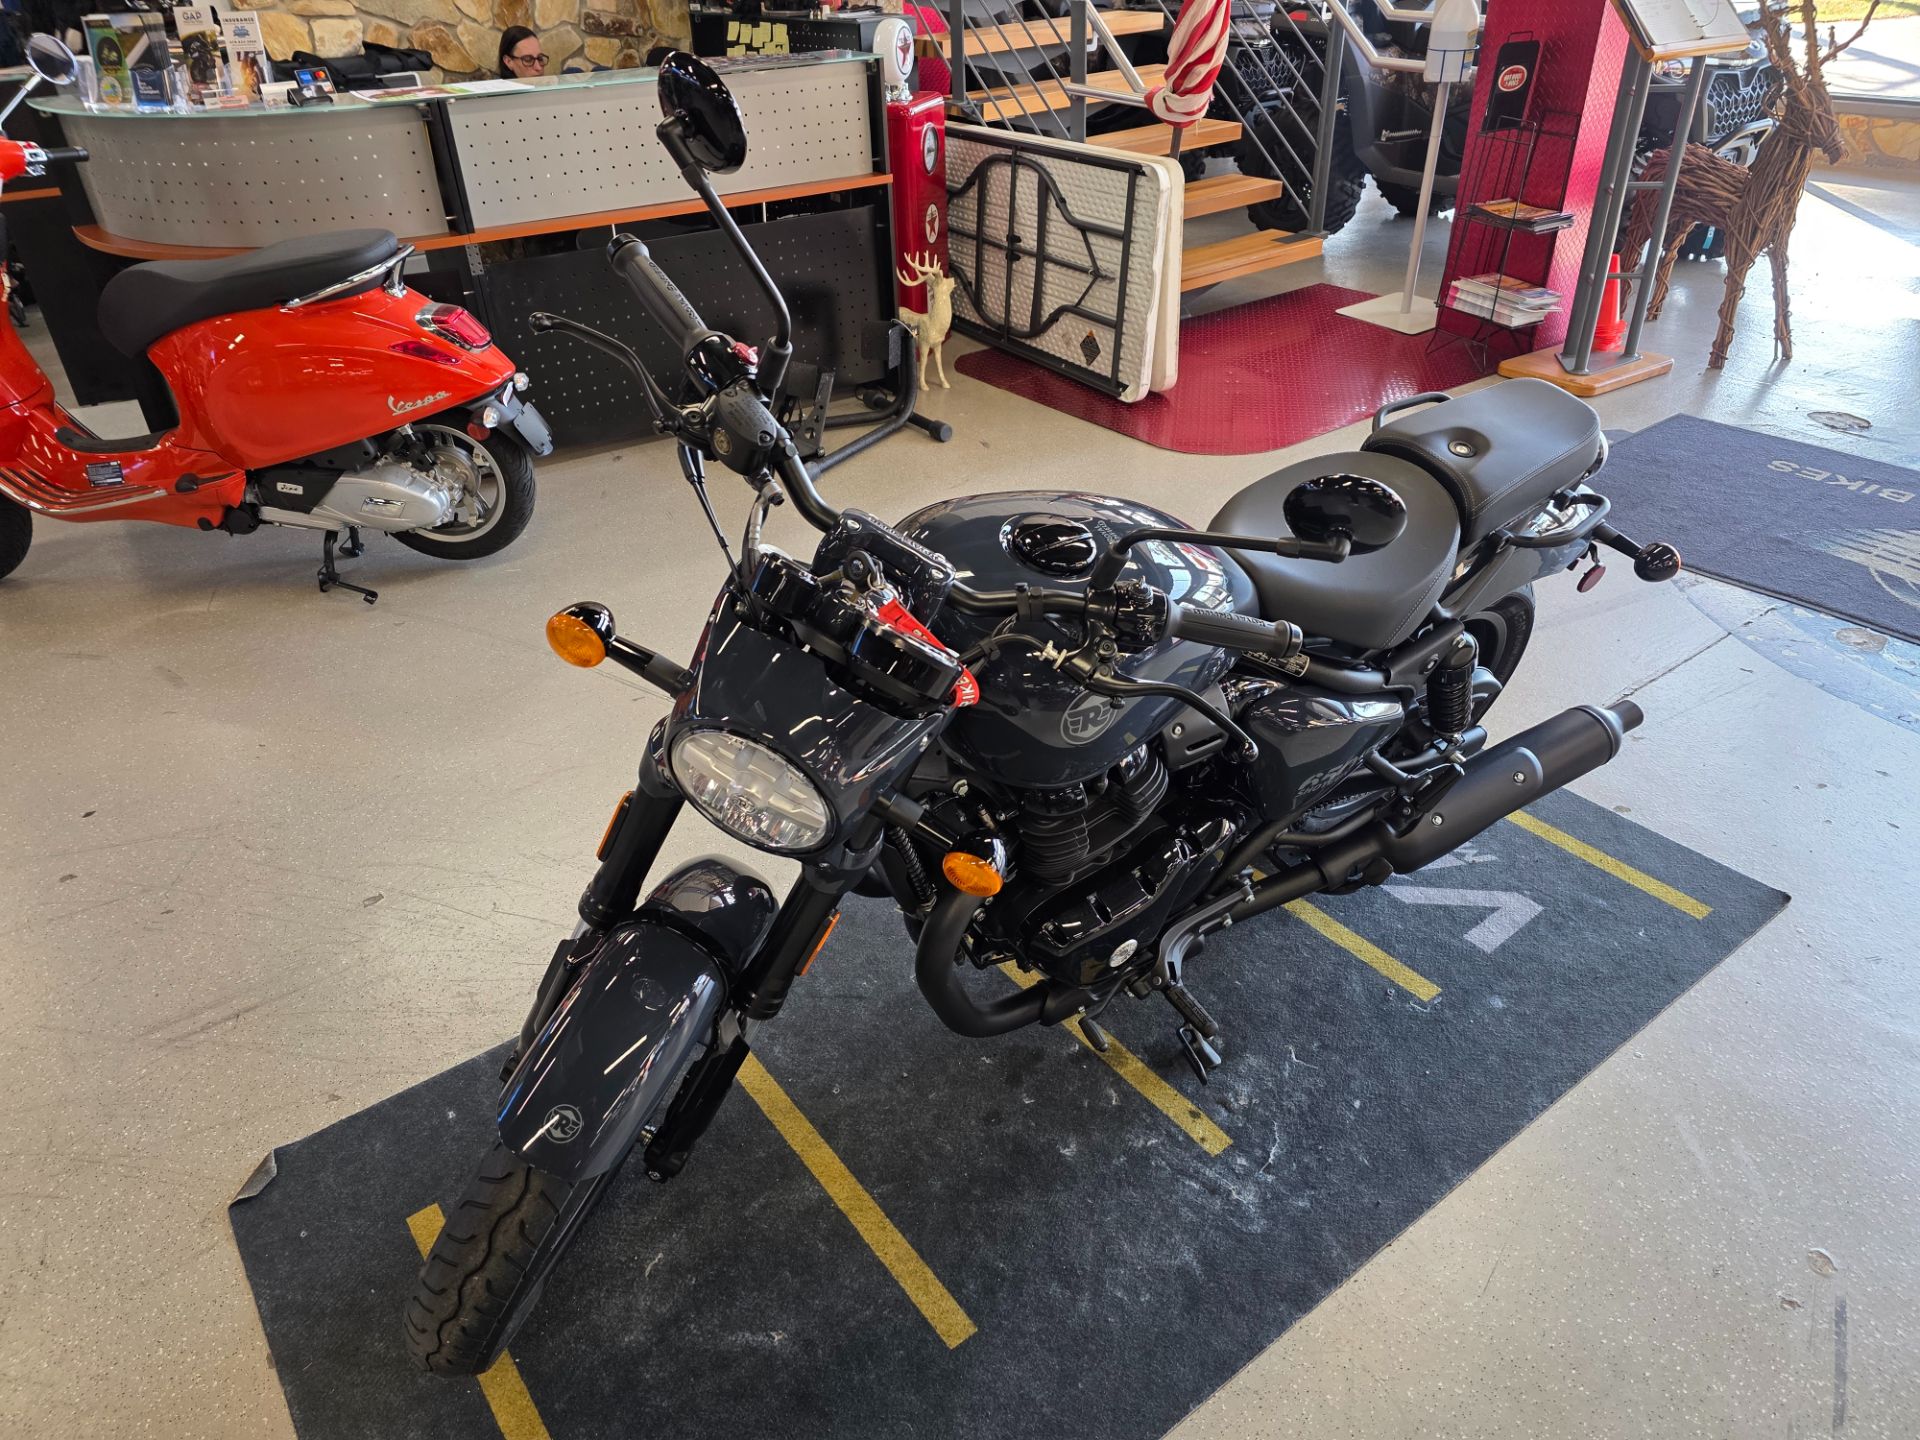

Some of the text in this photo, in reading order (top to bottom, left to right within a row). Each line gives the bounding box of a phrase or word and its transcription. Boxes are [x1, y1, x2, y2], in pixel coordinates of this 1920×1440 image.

[182, 11, 203, 21] GAP
[387, 391, 453, 417] Vespa
[1767, 460, 1916, 503] BIKES
